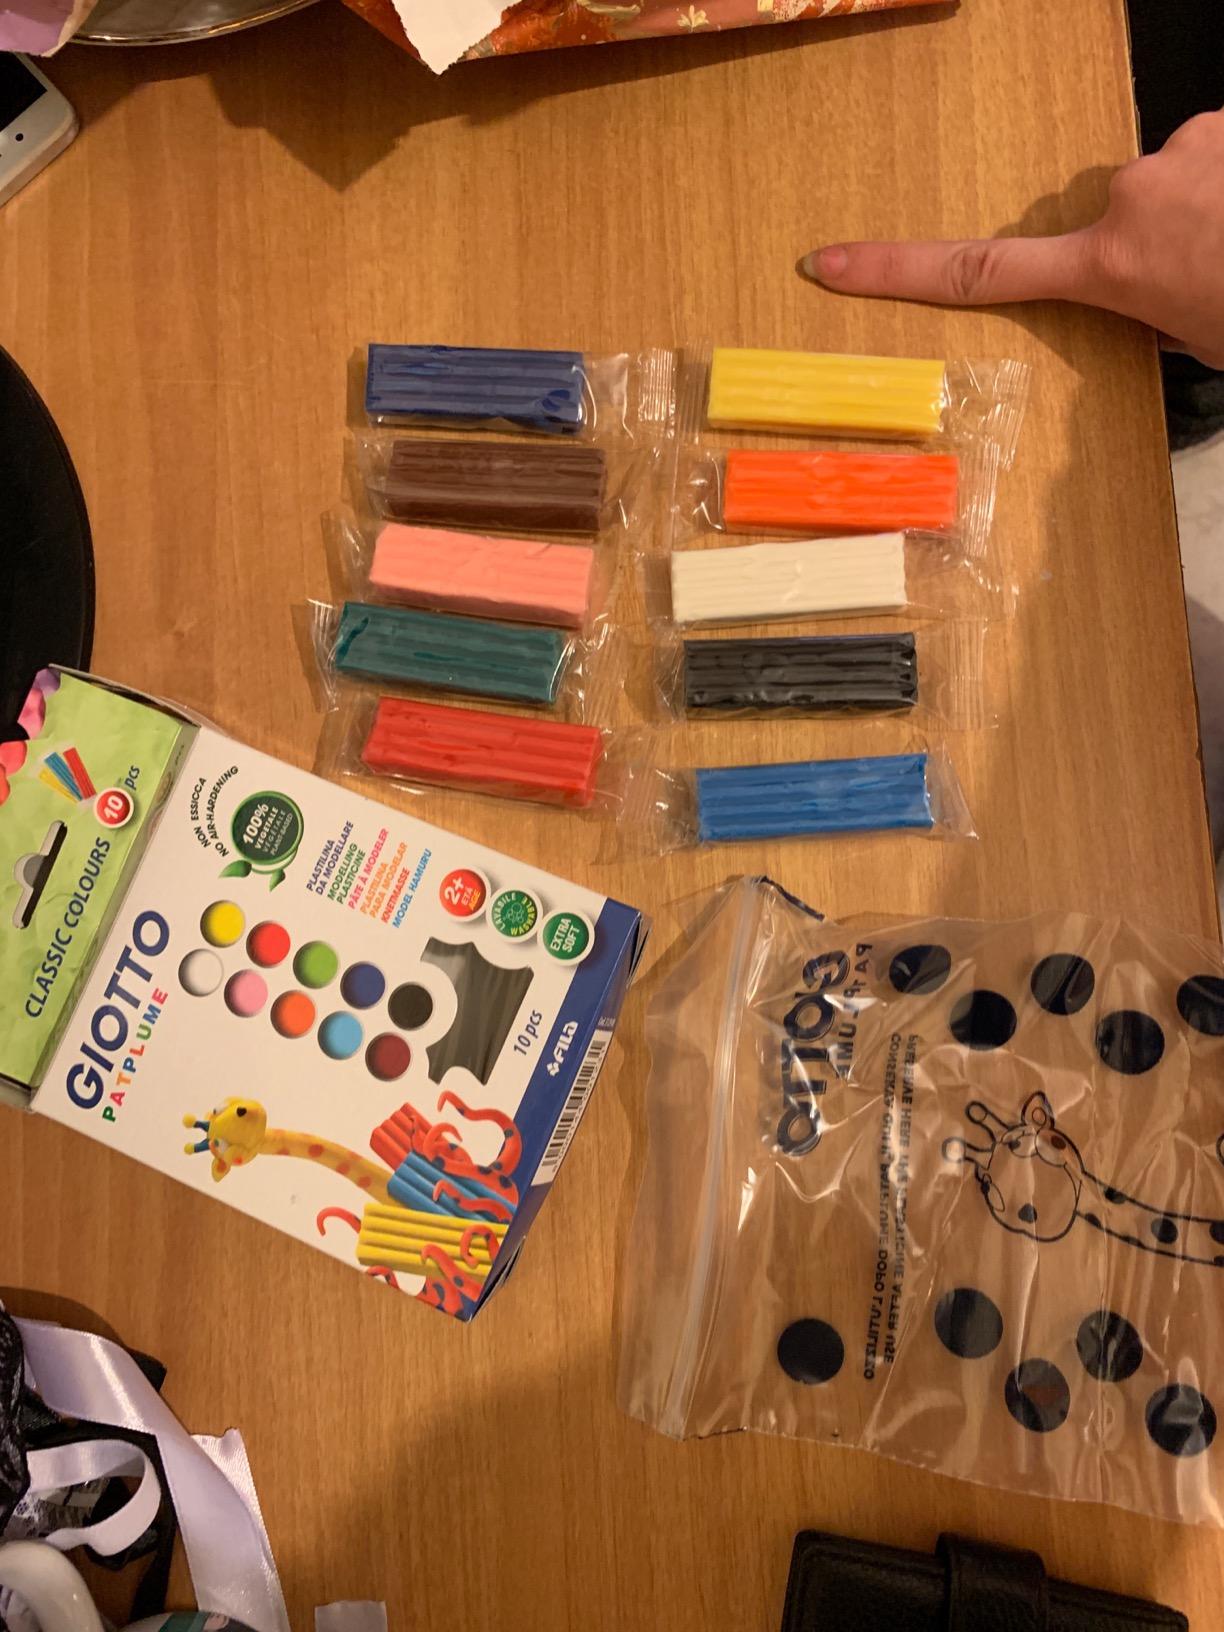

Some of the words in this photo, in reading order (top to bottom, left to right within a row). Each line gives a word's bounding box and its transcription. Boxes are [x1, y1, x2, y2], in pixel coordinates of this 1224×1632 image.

[104, 795, 124, 819] 10
[124, 765, 141, 791] pcs
[191, 777, 207, 821] ESSICCA
[206, 765, 239, 840] AIR-HARDENING
[194, 826, 211, 848] NON
[215, 842, 229, 857] NO
[243, 803, 269, 845] 100%
[255, 806, 279, 850] VEGETALE
[306, 839, 335, 892] PLASTILINA
[315, 881, 328, 895] DA
[323, 820, 354, 879] MODELLARE
[327, 843, 358, 900] MODELLING
[336, 849, 366, 905] PLASTICINE
[348, 884, 364, 909] PÂTE
[363, 828, 389, 875] MODELER
[369, 892, 386, 918] PARA
[382, 842, 408, 890] MODELAR
[360, 863, 389, 914] PLASTILINA
[381, 867, 410, 924] KNETMASSE
[392, 894, 413, 928] MODEL
[409, 848, 432, 892] HAMURU
[444, 876, 465, 905] 2+
[468, 890, 481, 911] AGE
[493, 892, 516, 930] LAVABILE
[25, 927, 72, 1018] CLASSIC
[64, 836, 111, 929] COLOURS
[510, 897, 537, 935] WASHABLE
[551, 918, 571, 951] EXTRA
[562, 925, 580, 952] SOFT
[66, 910, 170, 1109] GIOTTO
[513, 1035, 531, 1056] 10
[525, 1010, 543, 1039] pcs
[102, 988, 169, 1122] PATPLUME
